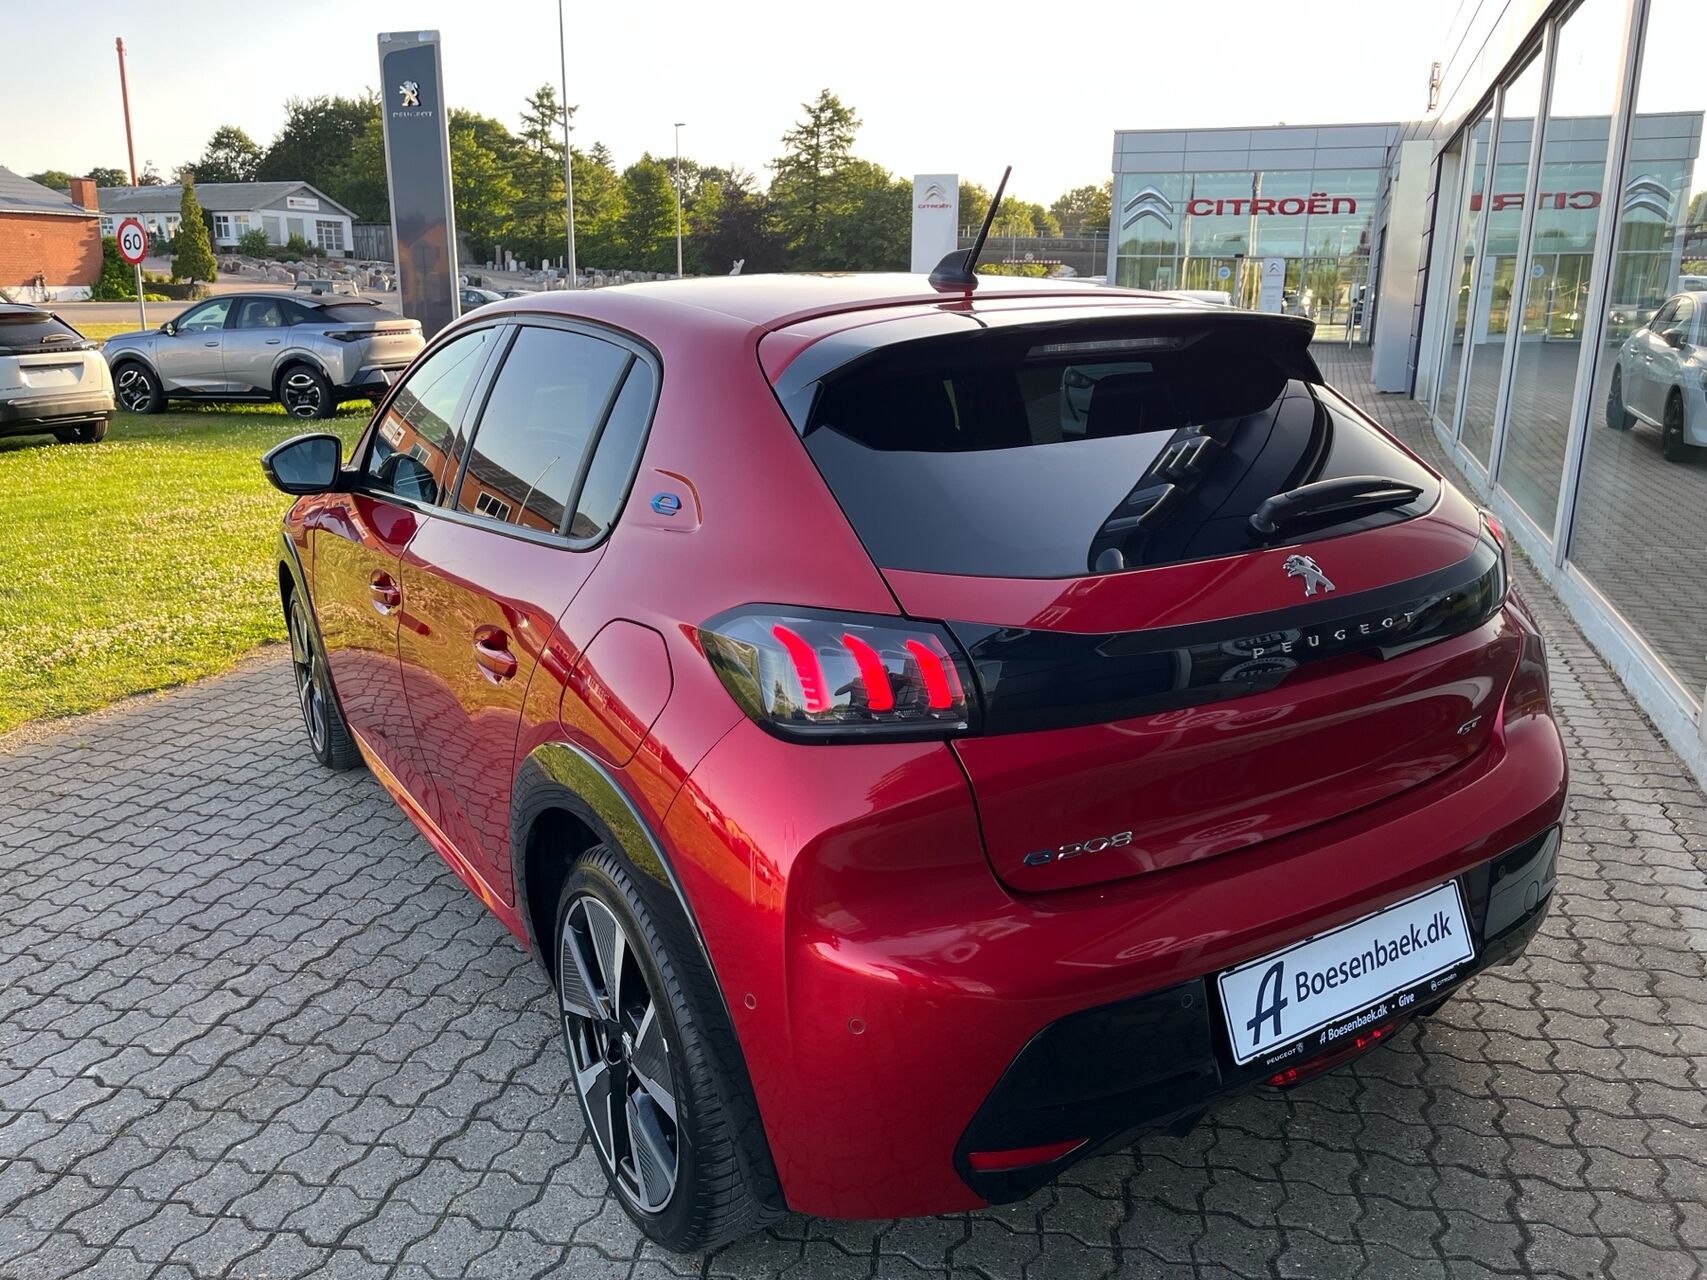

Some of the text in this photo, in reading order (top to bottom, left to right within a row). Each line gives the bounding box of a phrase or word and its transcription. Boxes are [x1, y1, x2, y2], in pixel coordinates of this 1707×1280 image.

[123, 233, 142, 250] 60
[1252, 611, 1414, 659] PEUGEOT
[1295, 911, 1452, 1003] Boesenbaek.dk
[1328, 1003, 1389, 1041] Boesenbaek.dk
[1398, 991, 1416, 1008] Give
[1266, 1048, 1297, 1065] PEUGEOT
